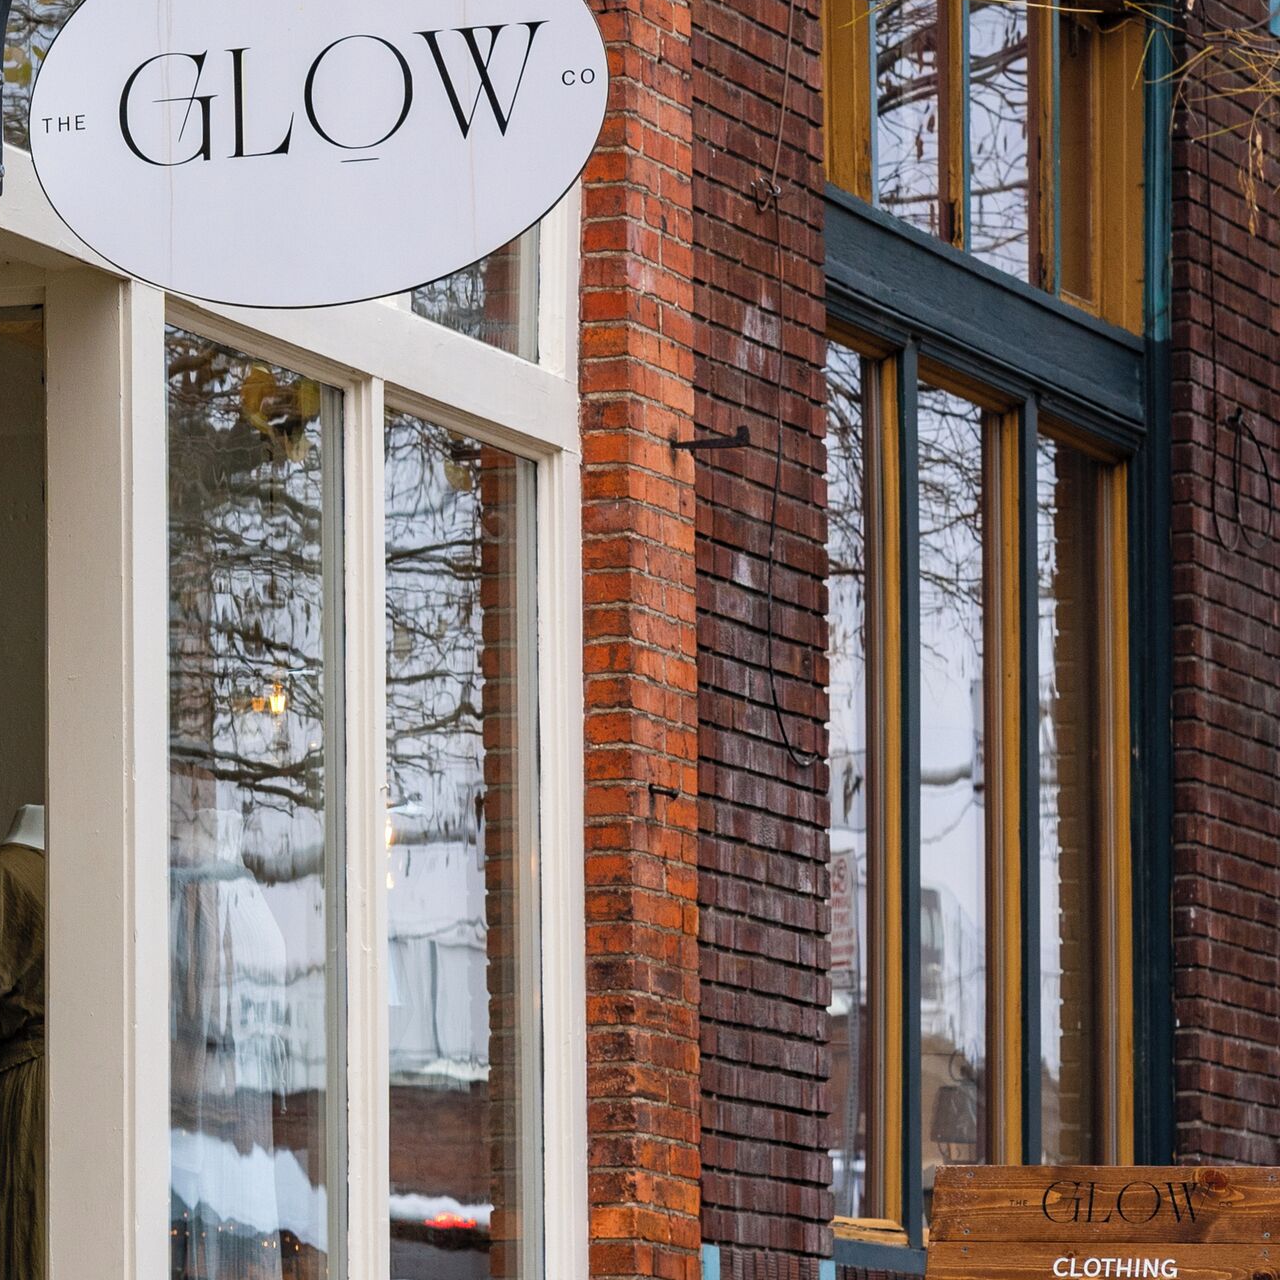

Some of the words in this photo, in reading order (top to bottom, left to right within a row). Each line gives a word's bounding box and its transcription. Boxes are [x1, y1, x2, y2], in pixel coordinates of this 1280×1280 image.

[41, 113, 87, 135] THE
[118, 19, 549, 167] GLOW
[561, 67, 596, 87] CO
[1010, 1199, 1029, 1207] THE
[1042, 1180, 1216, 1225] GLOW
[1053, 1257, 1178, 1279] CLOTHING
